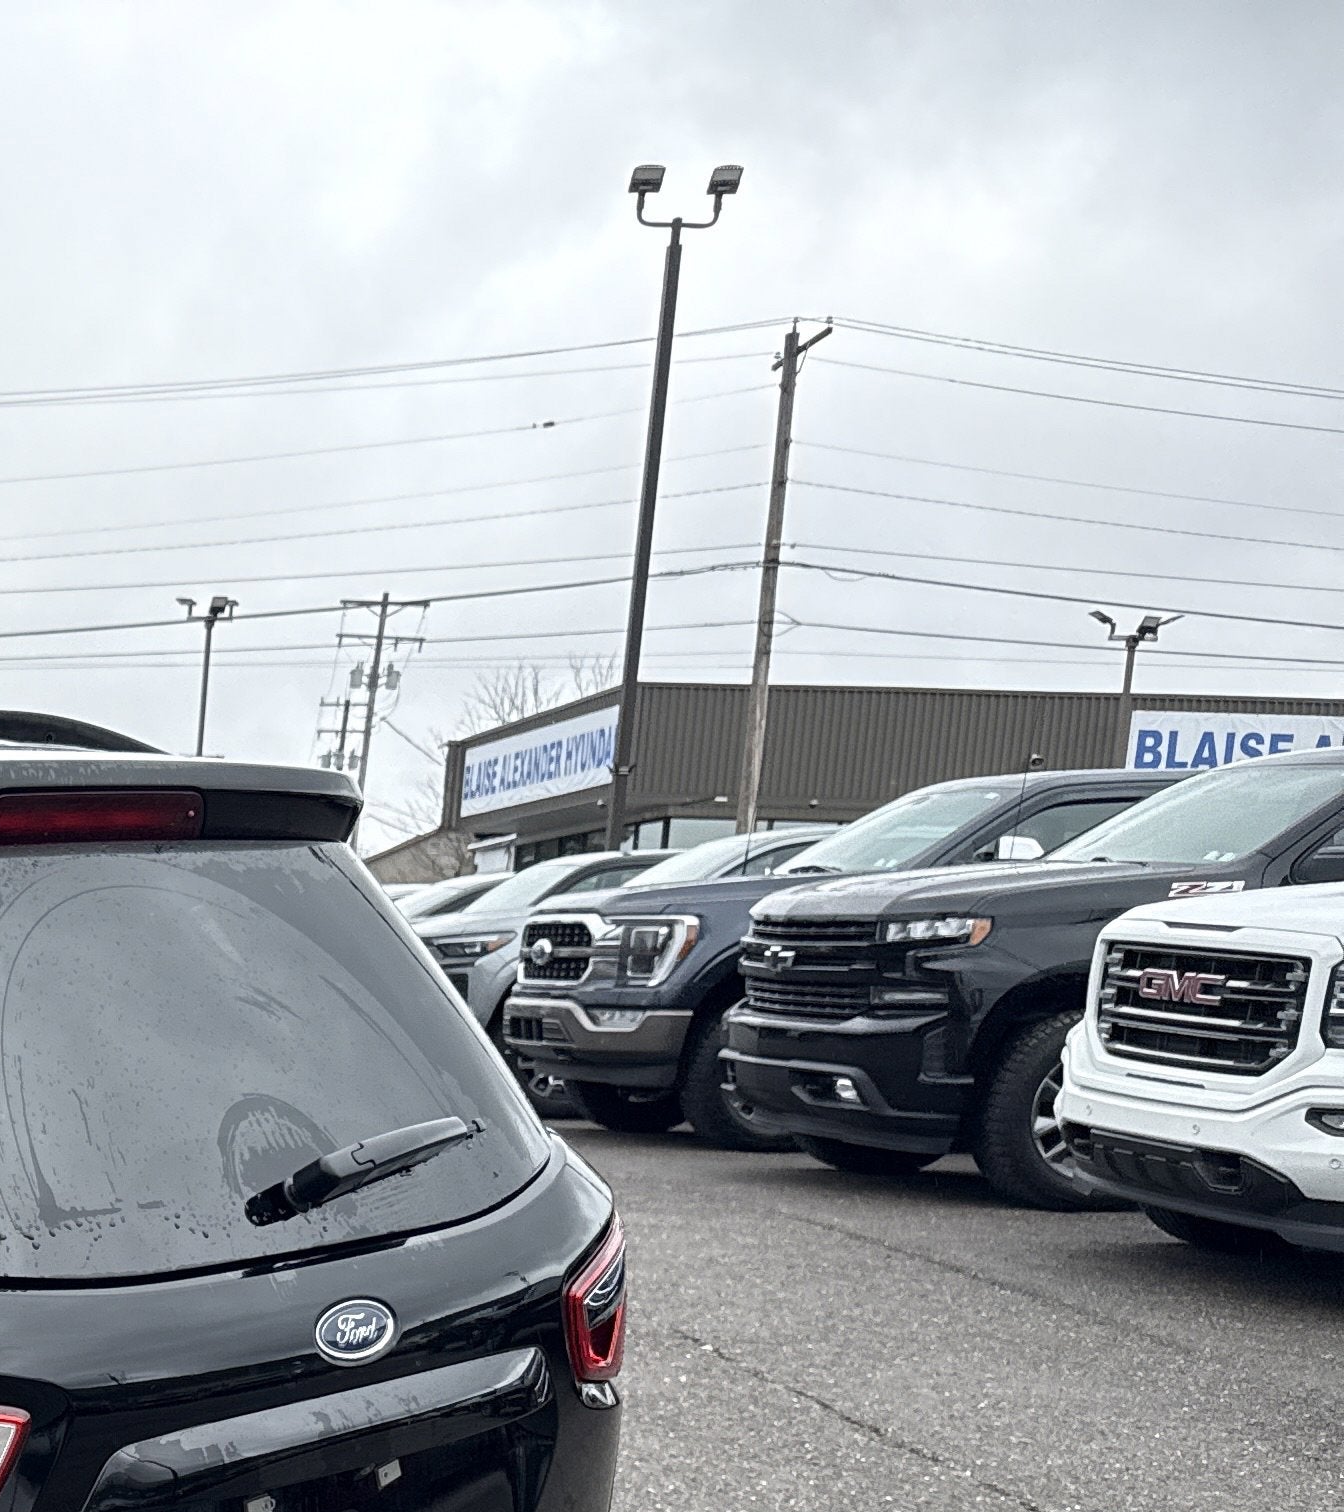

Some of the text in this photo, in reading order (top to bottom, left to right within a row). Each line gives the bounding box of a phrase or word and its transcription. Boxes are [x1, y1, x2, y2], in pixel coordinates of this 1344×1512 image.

[1134, 729, 1294, 770] BLAISE
[464, 756, 499, 800] BLAISE
[499, 740, 563, 793] ALEXANDER
[1168, 880, 1245, 898] Z71
[1139, 967, 1227, 1006] GMC
[336, 1312, 378, 1346] Ford
